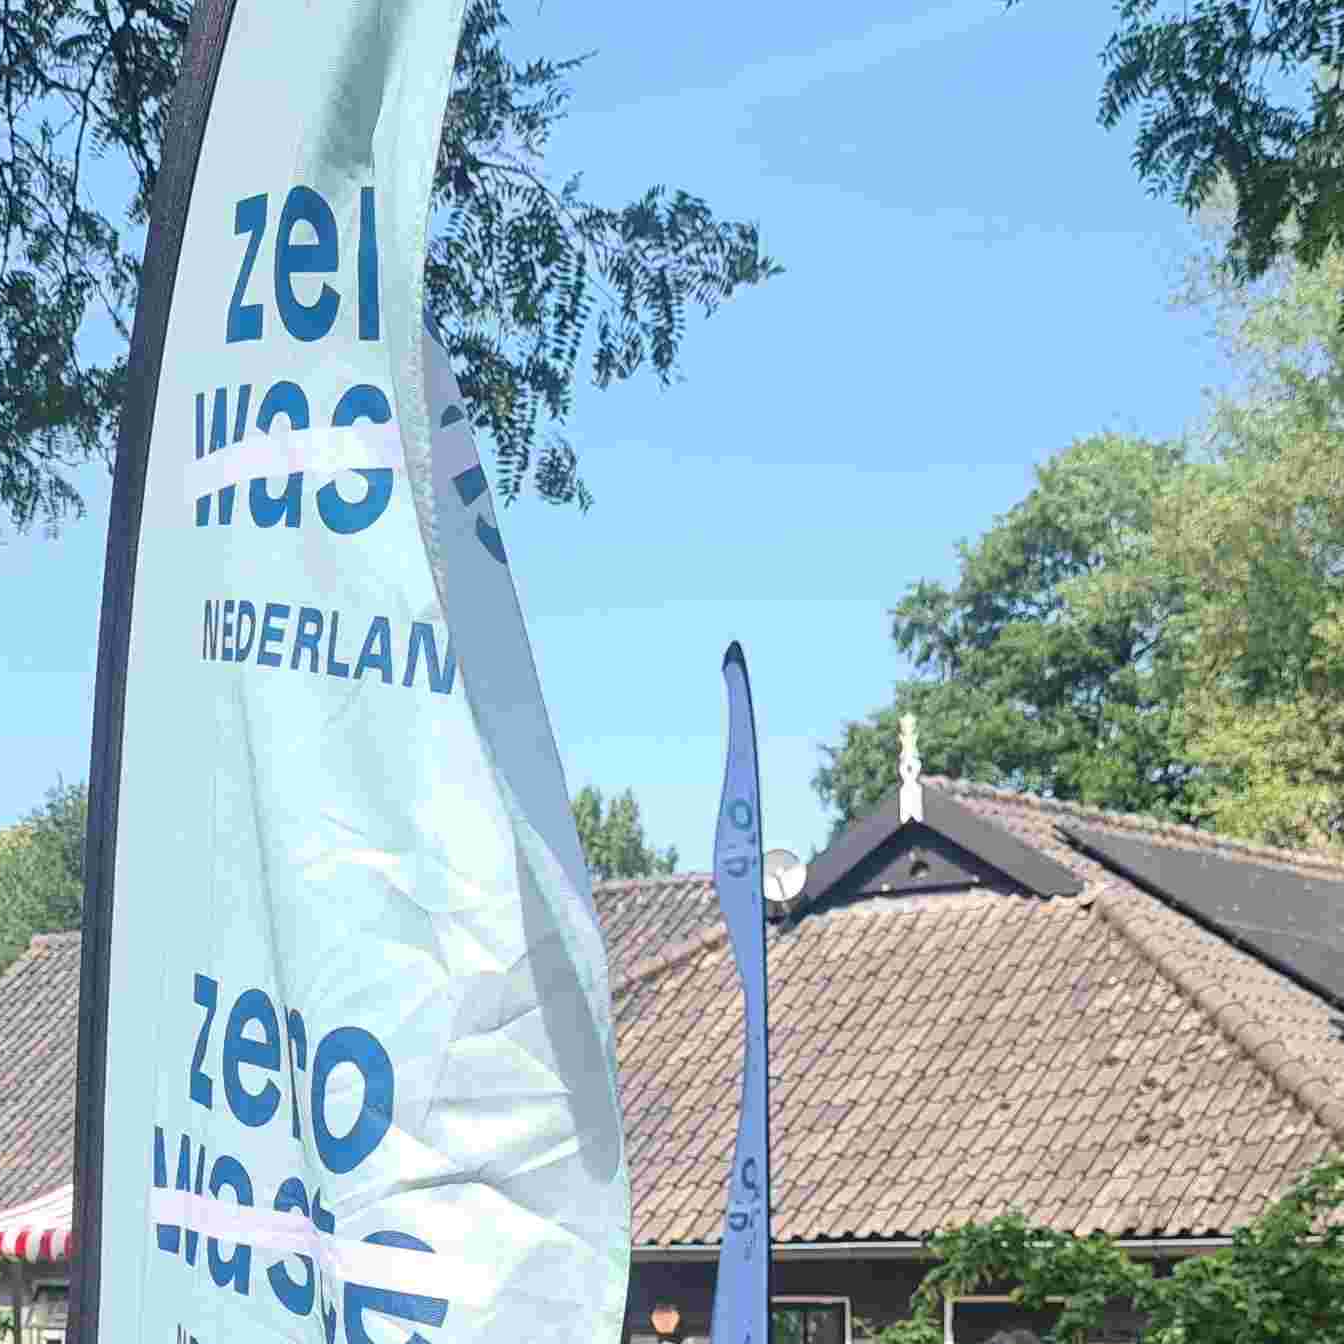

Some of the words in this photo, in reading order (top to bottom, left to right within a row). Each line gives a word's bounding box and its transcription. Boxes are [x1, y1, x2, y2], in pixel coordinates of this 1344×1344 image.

[195, 380, 393, 535] was
[203, 600, 456, 694] NEDERLAN
[189, 973, 394, 1174] zero
